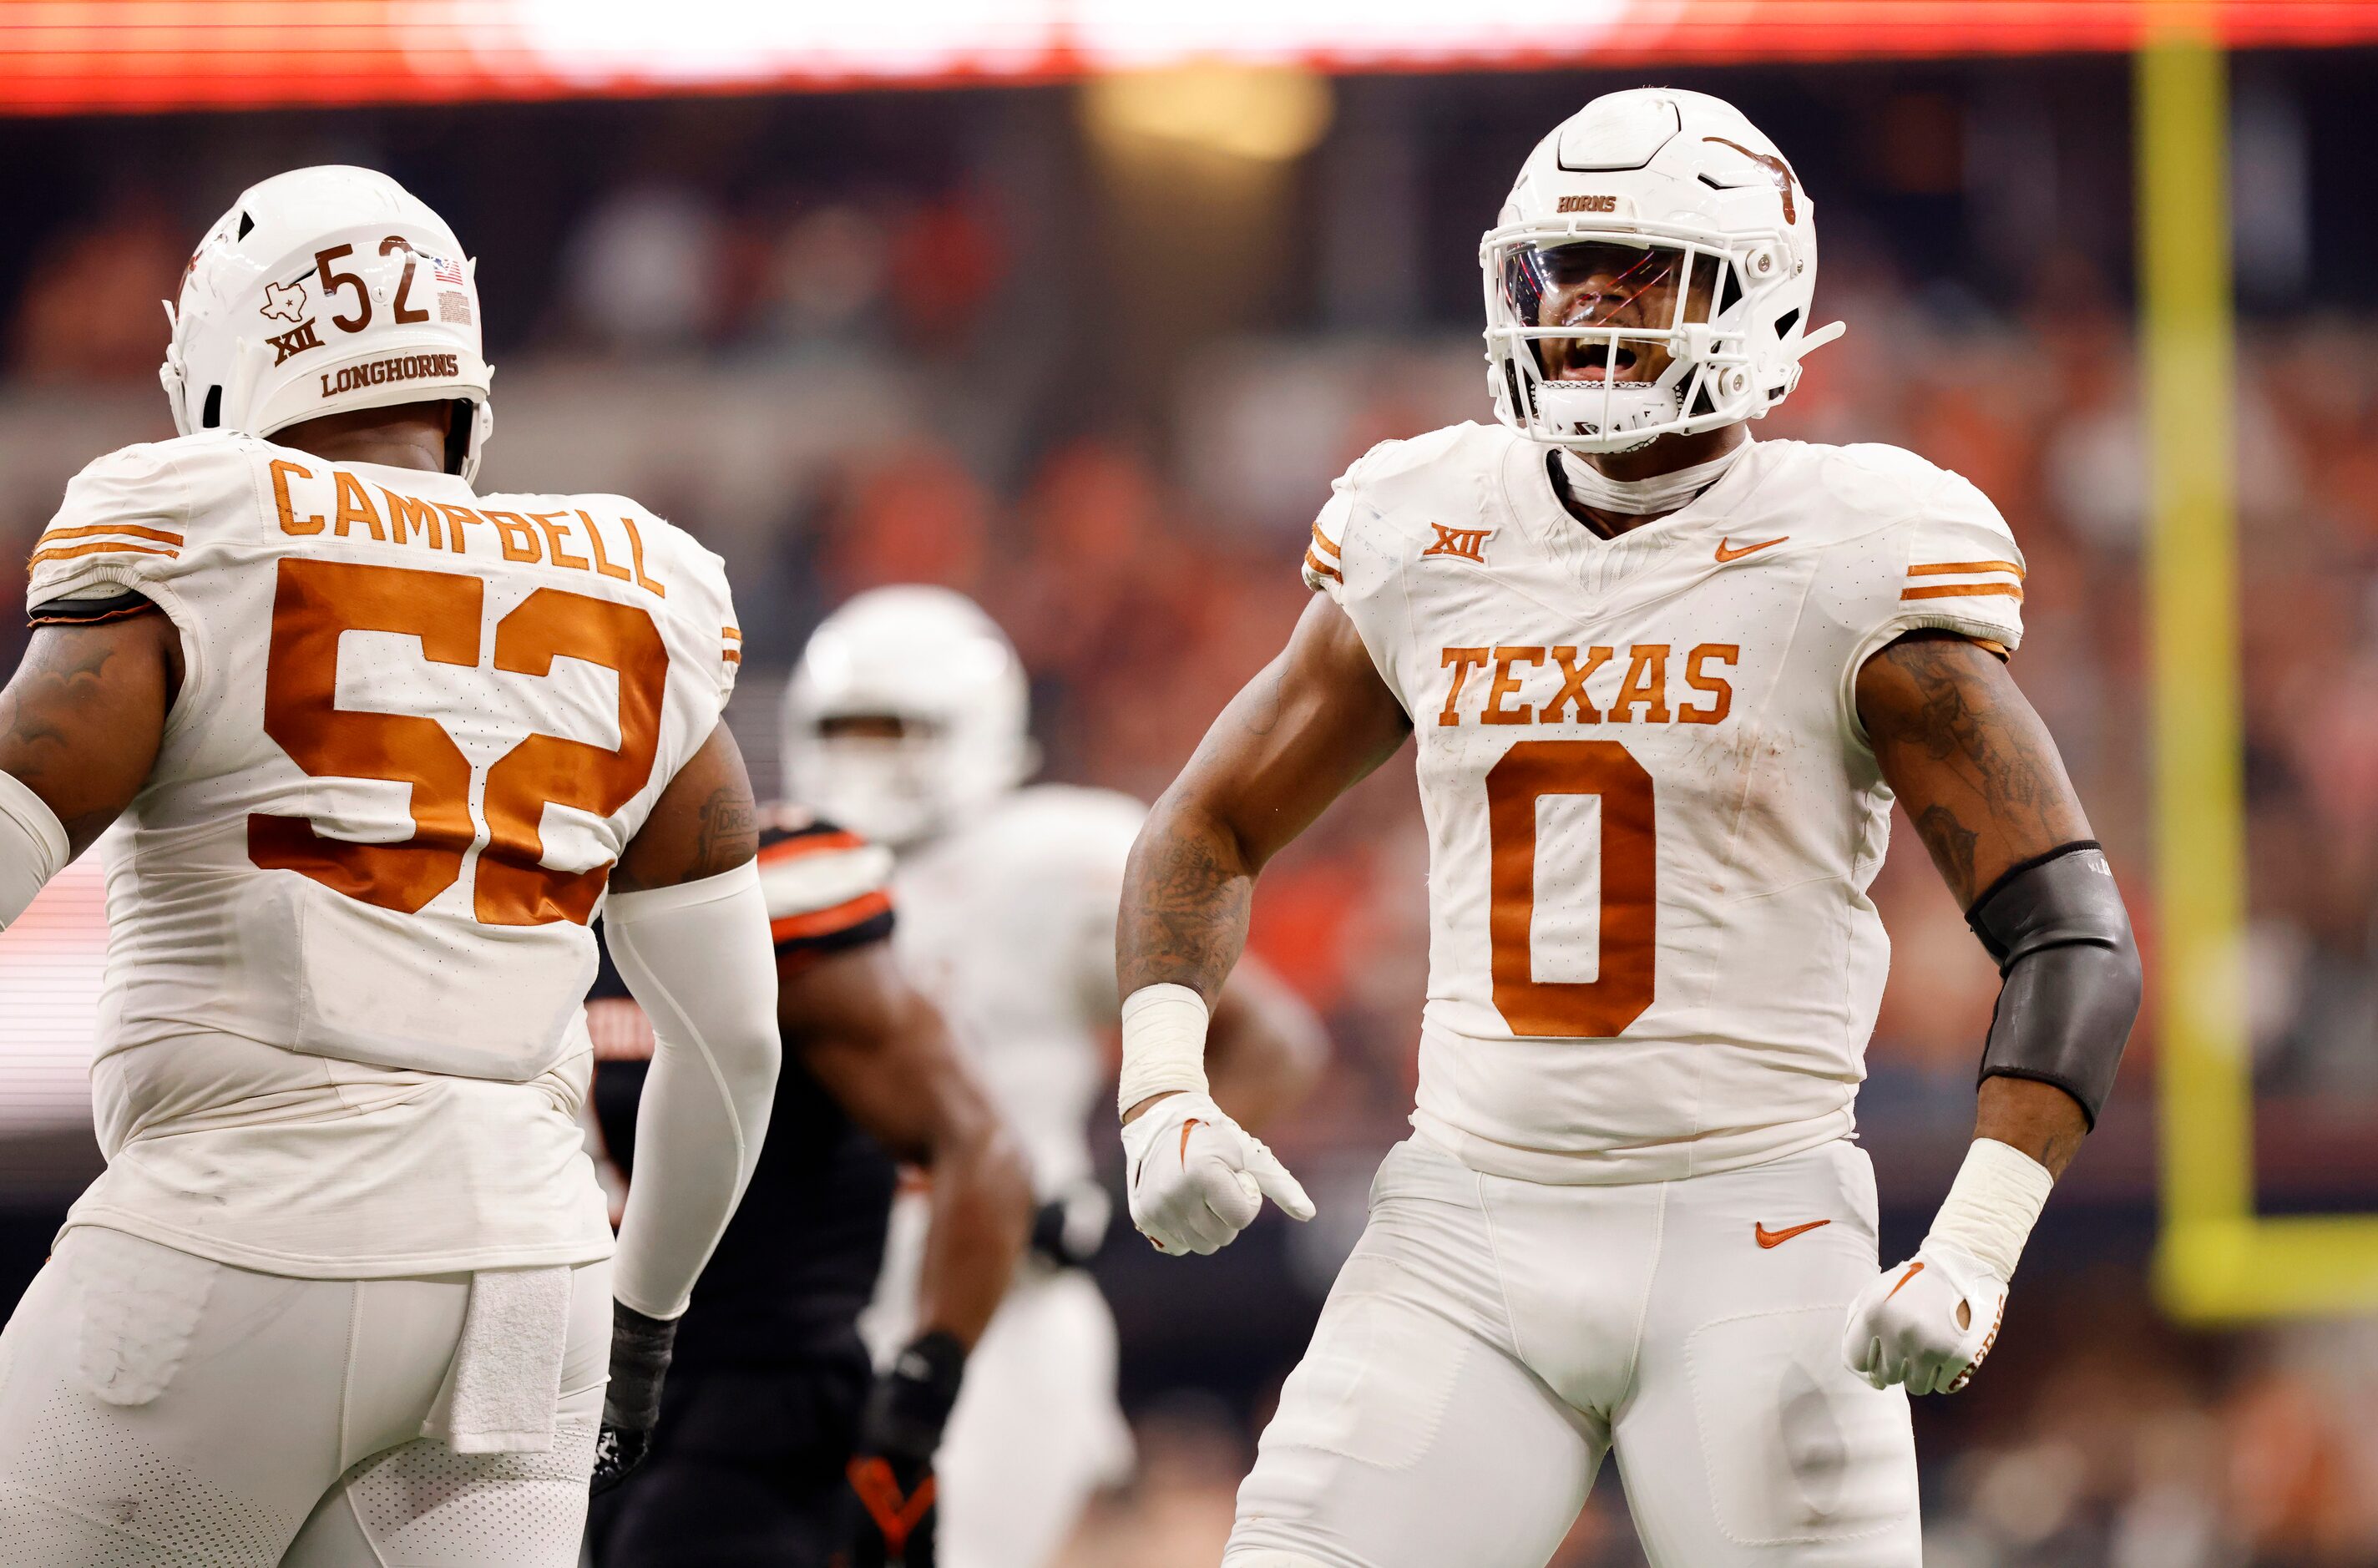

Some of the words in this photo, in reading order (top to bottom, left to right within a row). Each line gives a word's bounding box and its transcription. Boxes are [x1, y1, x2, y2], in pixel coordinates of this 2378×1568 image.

[1556, 195, 1617, 213] HORNS
[314, 235, 430, 334] 52
[265, 317, 325, 367] XII
[321, 354, 459, 398] LONGHORNS
[269, 458, 665, 599] CAMPBELL
[1423, 522, 1492, 563] XII
[1438, 644, 1740, 726] TEXAS
[247, 558, 670, 927] 52
[1485, 741, 1657, 1038] 0
